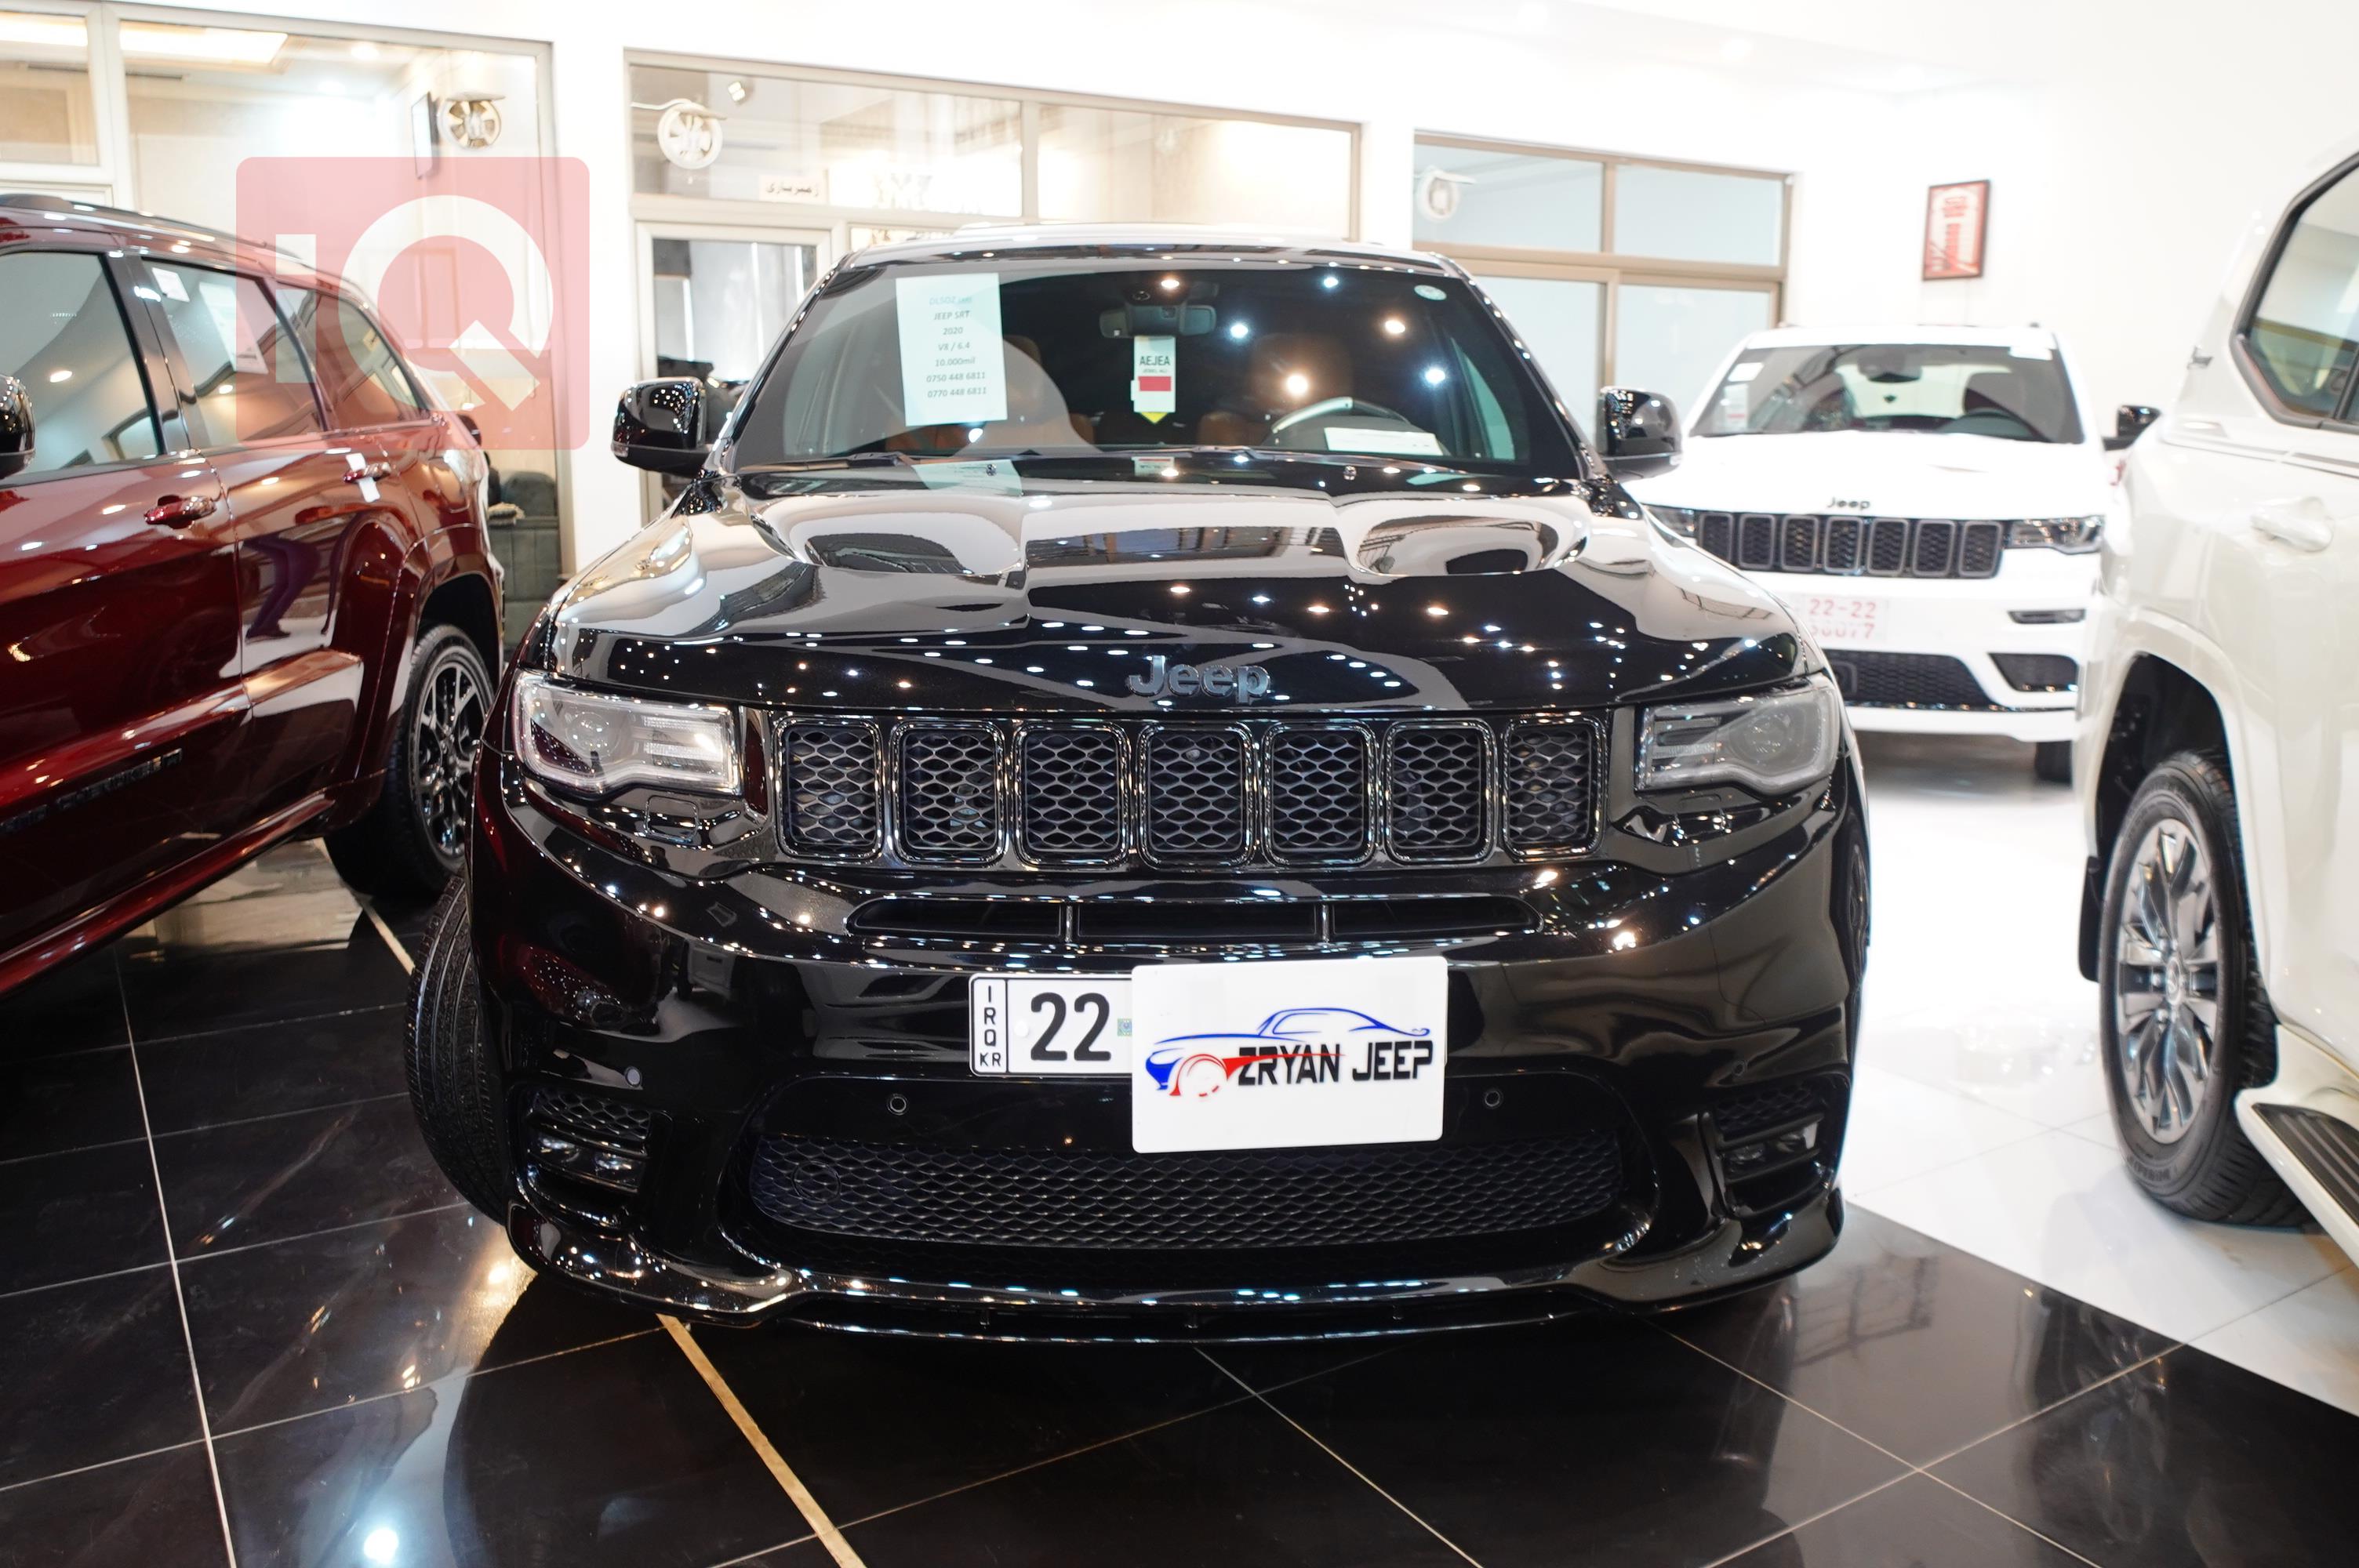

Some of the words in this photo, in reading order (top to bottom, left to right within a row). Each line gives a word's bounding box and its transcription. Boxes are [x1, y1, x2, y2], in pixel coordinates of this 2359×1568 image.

[933, 310, 953, 321] JEEP
[954, 310, 971, 320] SRT
[943, 326, 964, 336] 2020
[938, 343, 950, 352] V8
[958, 341, 971, 350] 6.4
[1140, 356, 1170, 366] AEJEA
[926, 373, 947, 383] 0750
[949, 372, 964, 382] 448
[965, 371, 986, 381] 6811
[927, 388, 948, 398] 0770
[950, 387, 965, 397] 448
[966, 387, 987, 397] 6811
[1827, 497, 1871, 510] Jeep
[1126, 655, 1270, 705] Jeep
[1030, 992, 1112, 1062] 22
[1237, 1042, 1343, 1087] ZRYAN
[1352, 1040, 1434, 1082] JEEP
